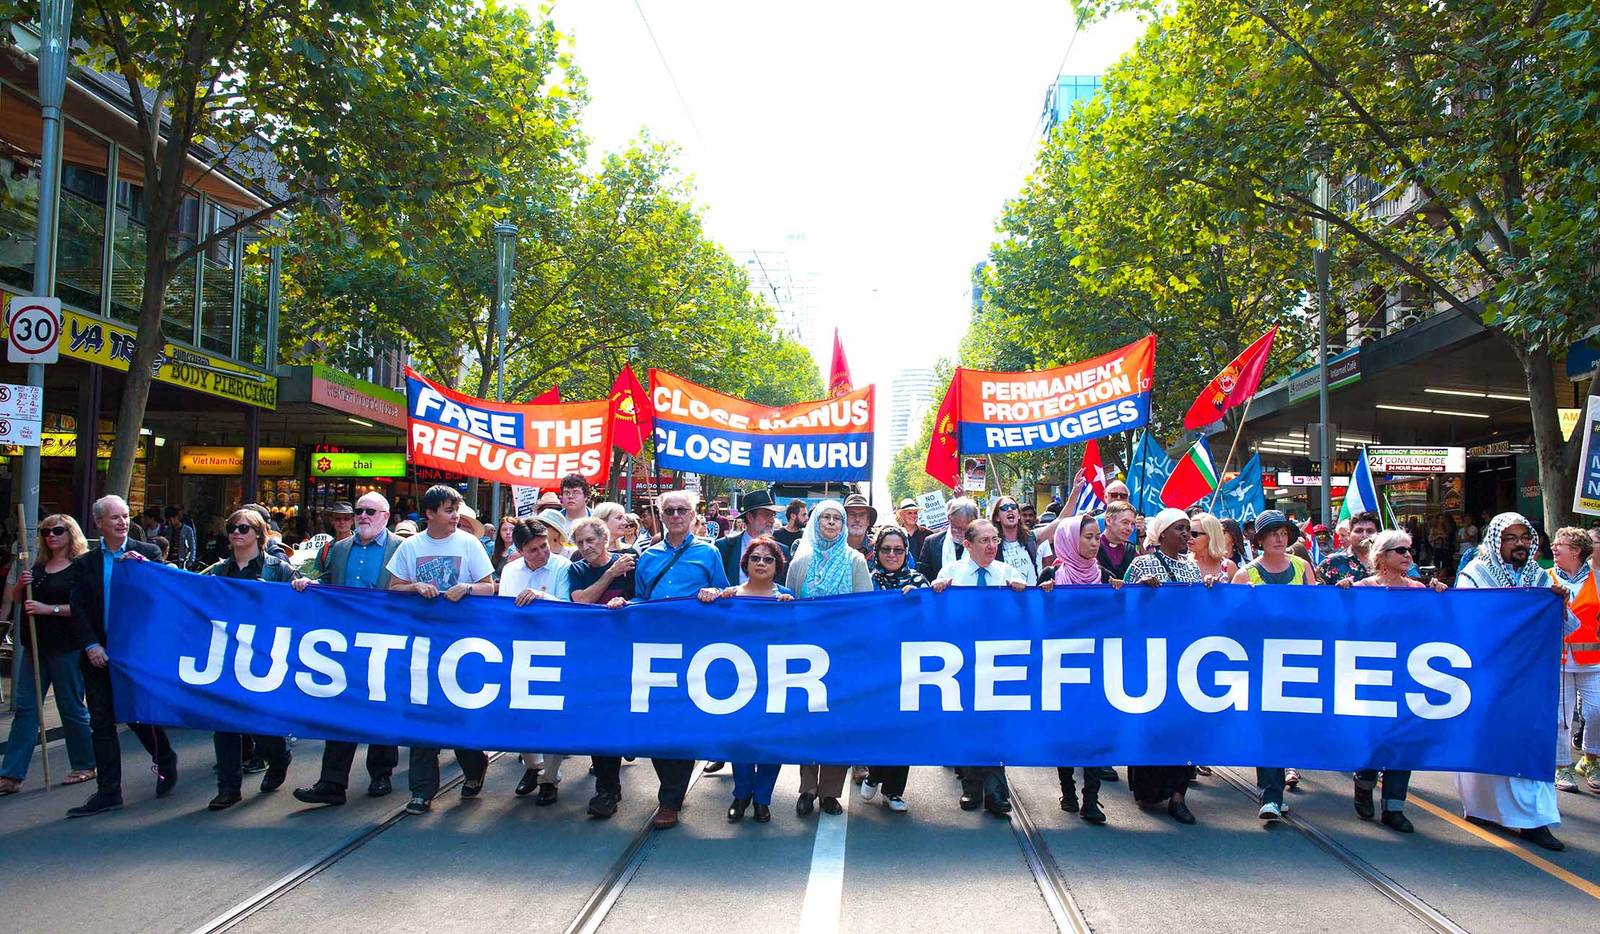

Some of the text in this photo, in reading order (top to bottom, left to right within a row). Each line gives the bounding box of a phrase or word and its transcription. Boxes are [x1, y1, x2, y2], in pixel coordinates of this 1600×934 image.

[16, 317, 52, 342] 30
[69, 316, 104, 354] YA
[171, 360, 275, 405] BODY PIERCING
[981, 356, 1125, 401] PERMANENT
[982, 374, 1132, 421] PROTECTION
[415, 386, 604, 448] FREE THE
[653, 386, 869, 431] CLOSE MANUS
[986, 400, 1139, 448] REFUGEES
[192, 457, 208, 465] Viet
[209, 457, 228, 465] Nam
[353, 460, 373, 469] thai
[412, 423, 601, 480] REFUGEES
[654, 427, 868, 469] CLOSE NAURU
[1370, 457, 1383, 467] 24
[925, 500, 940, 509] Boat
[178, 619, 1473, 720] JUSTICE FOR REFUGEES
